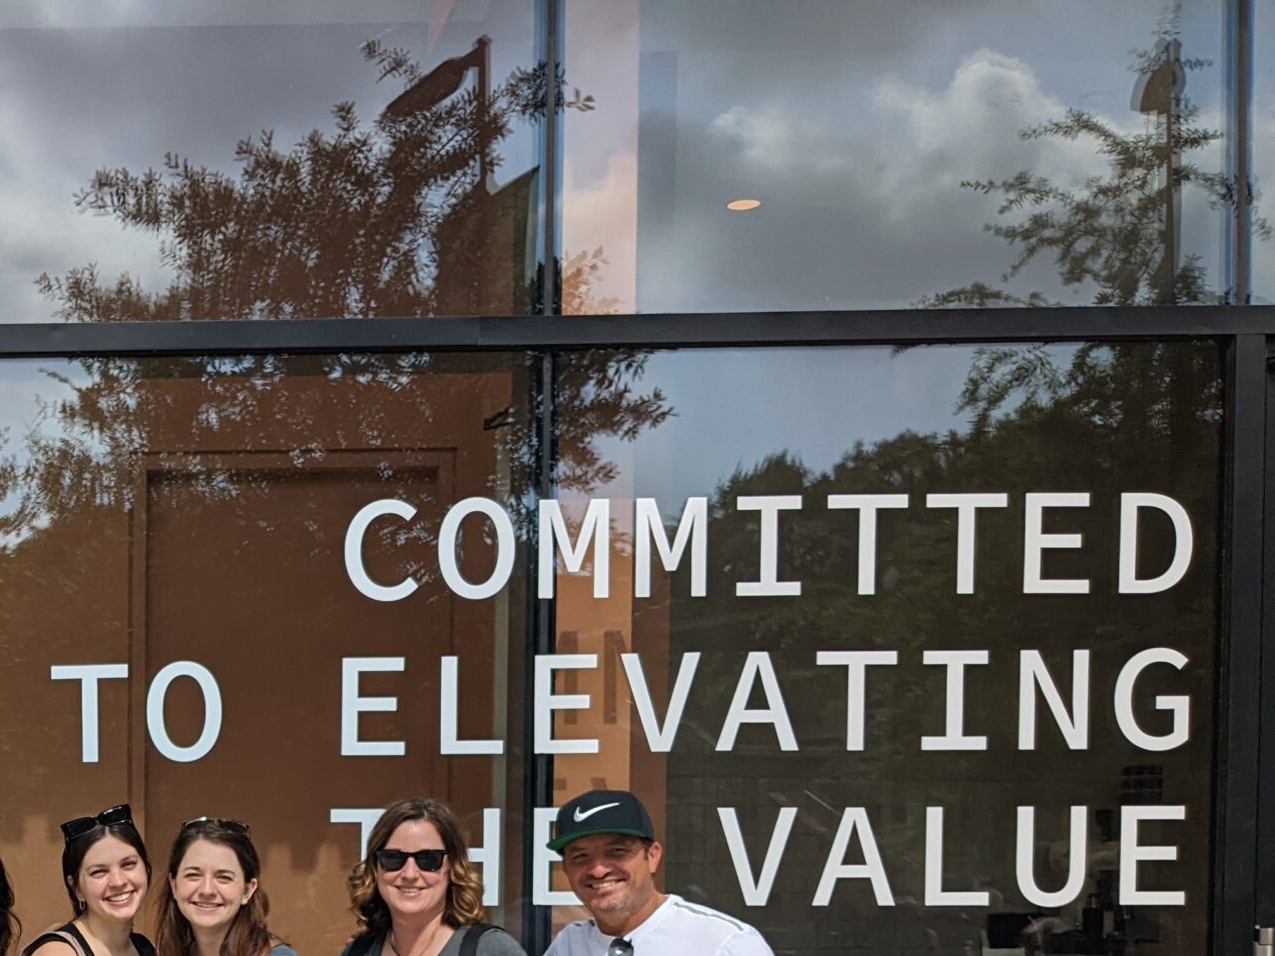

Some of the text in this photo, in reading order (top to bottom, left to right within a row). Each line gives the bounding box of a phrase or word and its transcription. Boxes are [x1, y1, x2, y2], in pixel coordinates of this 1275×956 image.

[344, 493, 1193, 602] COMMITTED
[50, 648, 1190, 763] TO ELEVATING
[716, 805, 1186, 908] VALUE
